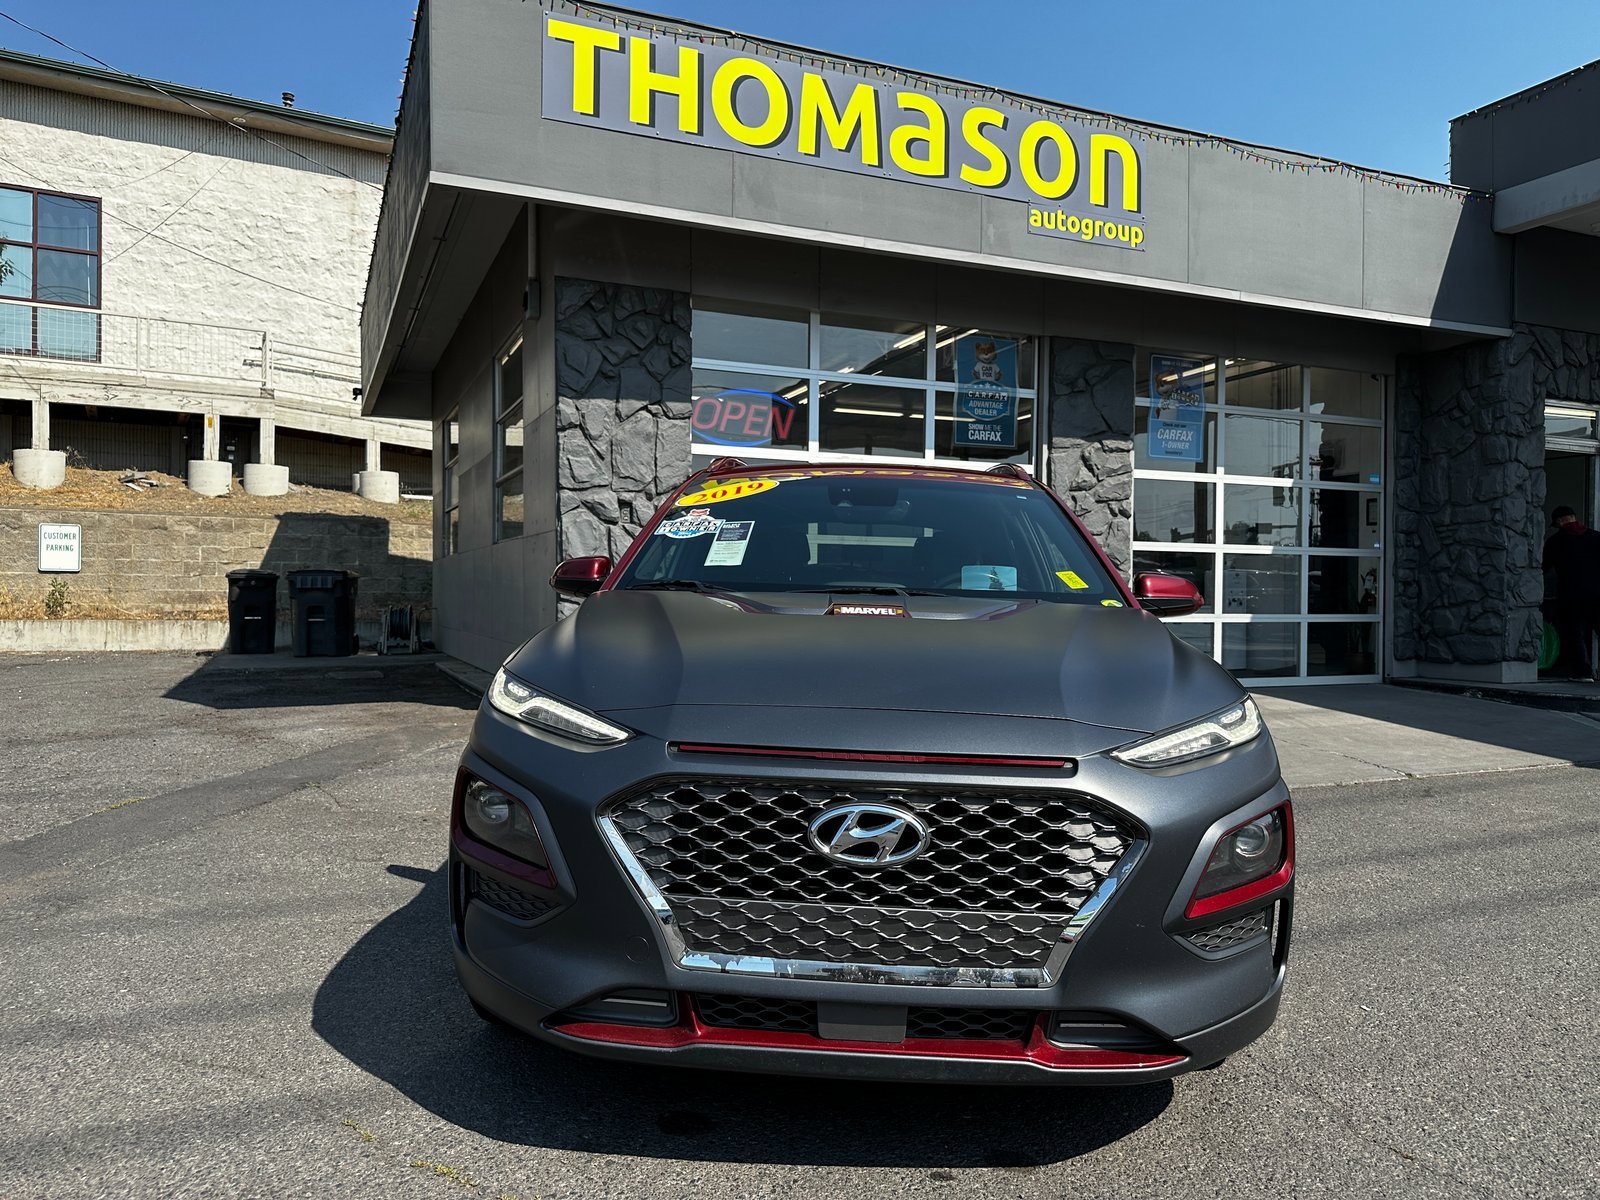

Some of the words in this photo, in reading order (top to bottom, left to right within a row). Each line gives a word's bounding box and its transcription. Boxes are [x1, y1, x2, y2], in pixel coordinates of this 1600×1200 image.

[1029, 209, 1144, 248] autogroup
[968, 391, 1008, 401] CARFAX
[968, 400, 1004, 409] ADVANTAGE
[974, 408, 998, 416] DEALER
[691, 396, 796, 440] OPEN
[968, 423, 984, 431] SHOW
[968, 430, 1002, 441] CARFAX
[1157, 428, 1193, 441] CARFAX
[692, 482, 764, 503] 2019
[43, 532, 77, 540] CUSTOMER
[840, 606, 897, 616] MARVEL
